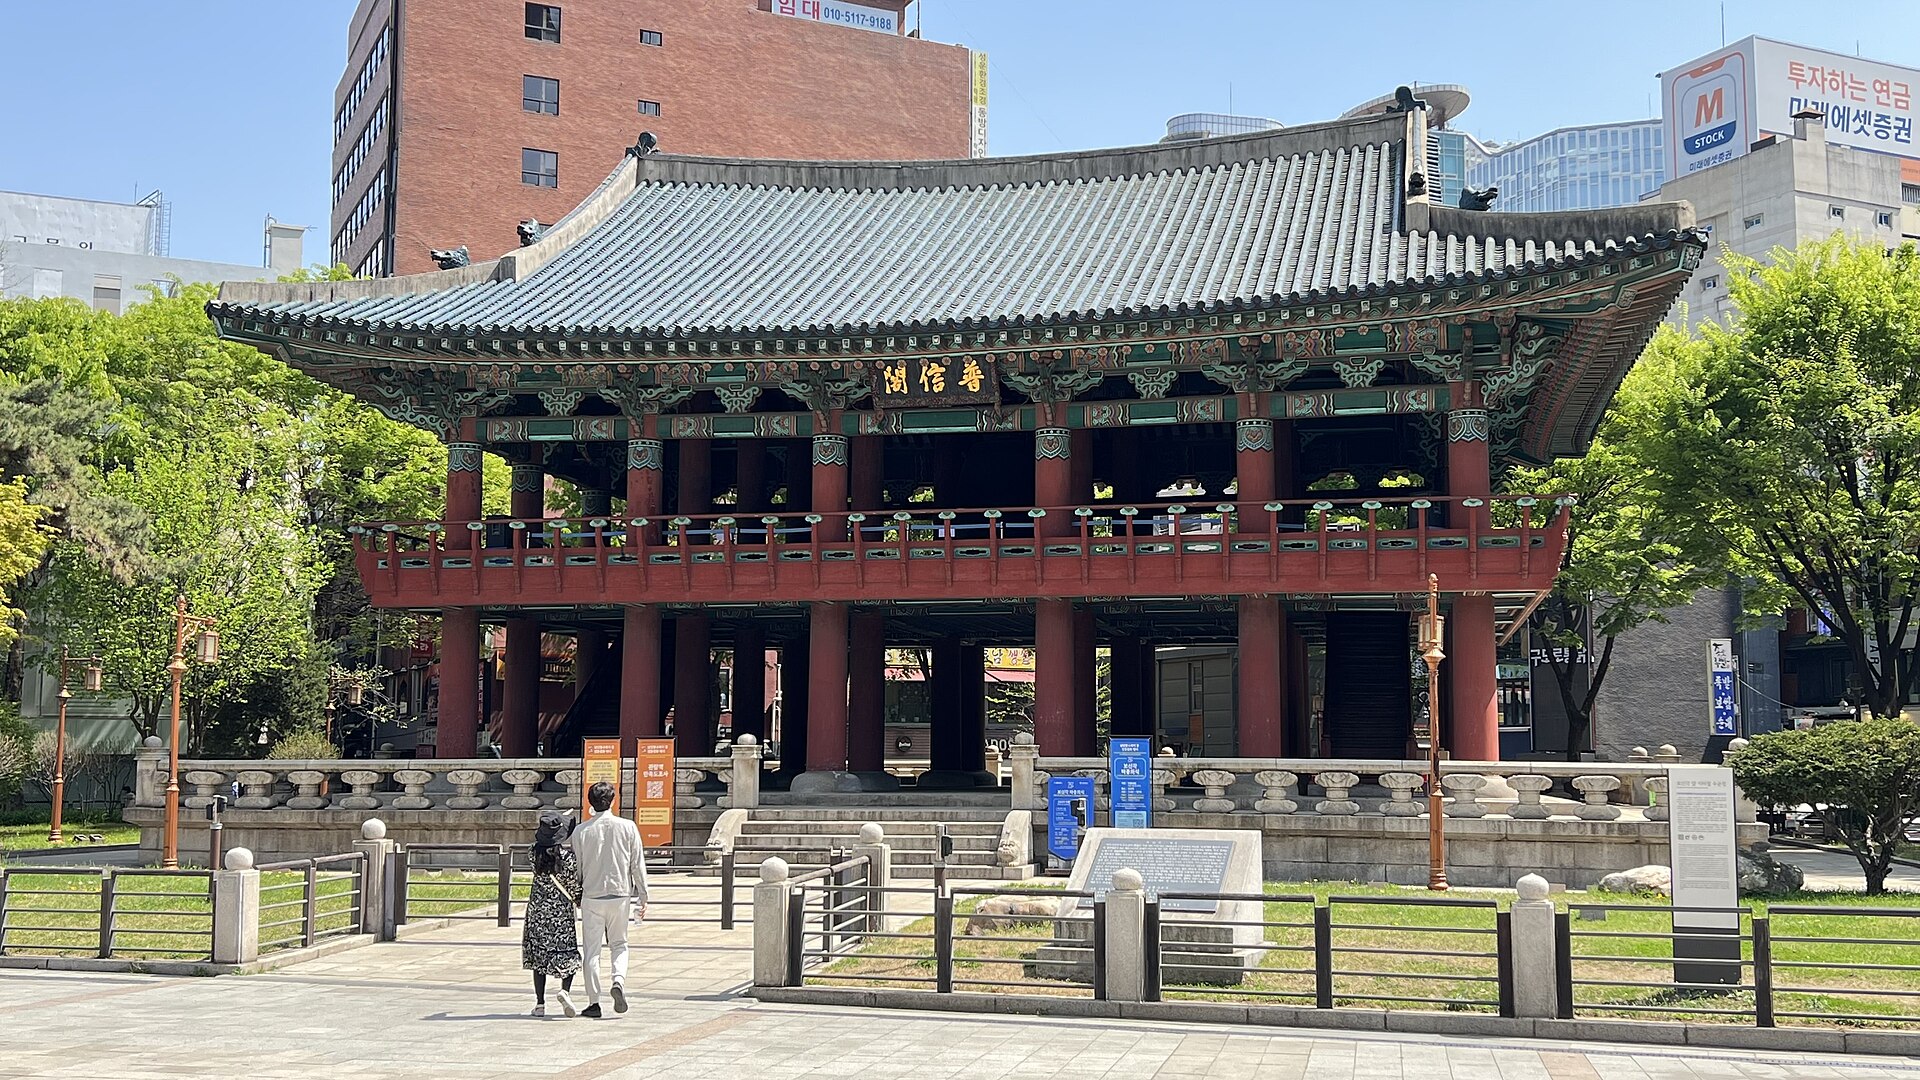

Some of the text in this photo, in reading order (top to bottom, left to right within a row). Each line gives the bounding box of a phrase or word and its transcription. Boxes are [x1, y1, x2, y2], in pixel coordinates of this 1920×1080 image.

[823, 7, 892, 30] 010-5117-9188
[1788, 61, 1911, 111] 투자하는 연금
[1694, 87, 1723, 128] M
[1694, 130, 1725, 149] STOCK
[1689, 149, 1733, 171] 미래에셋증권
